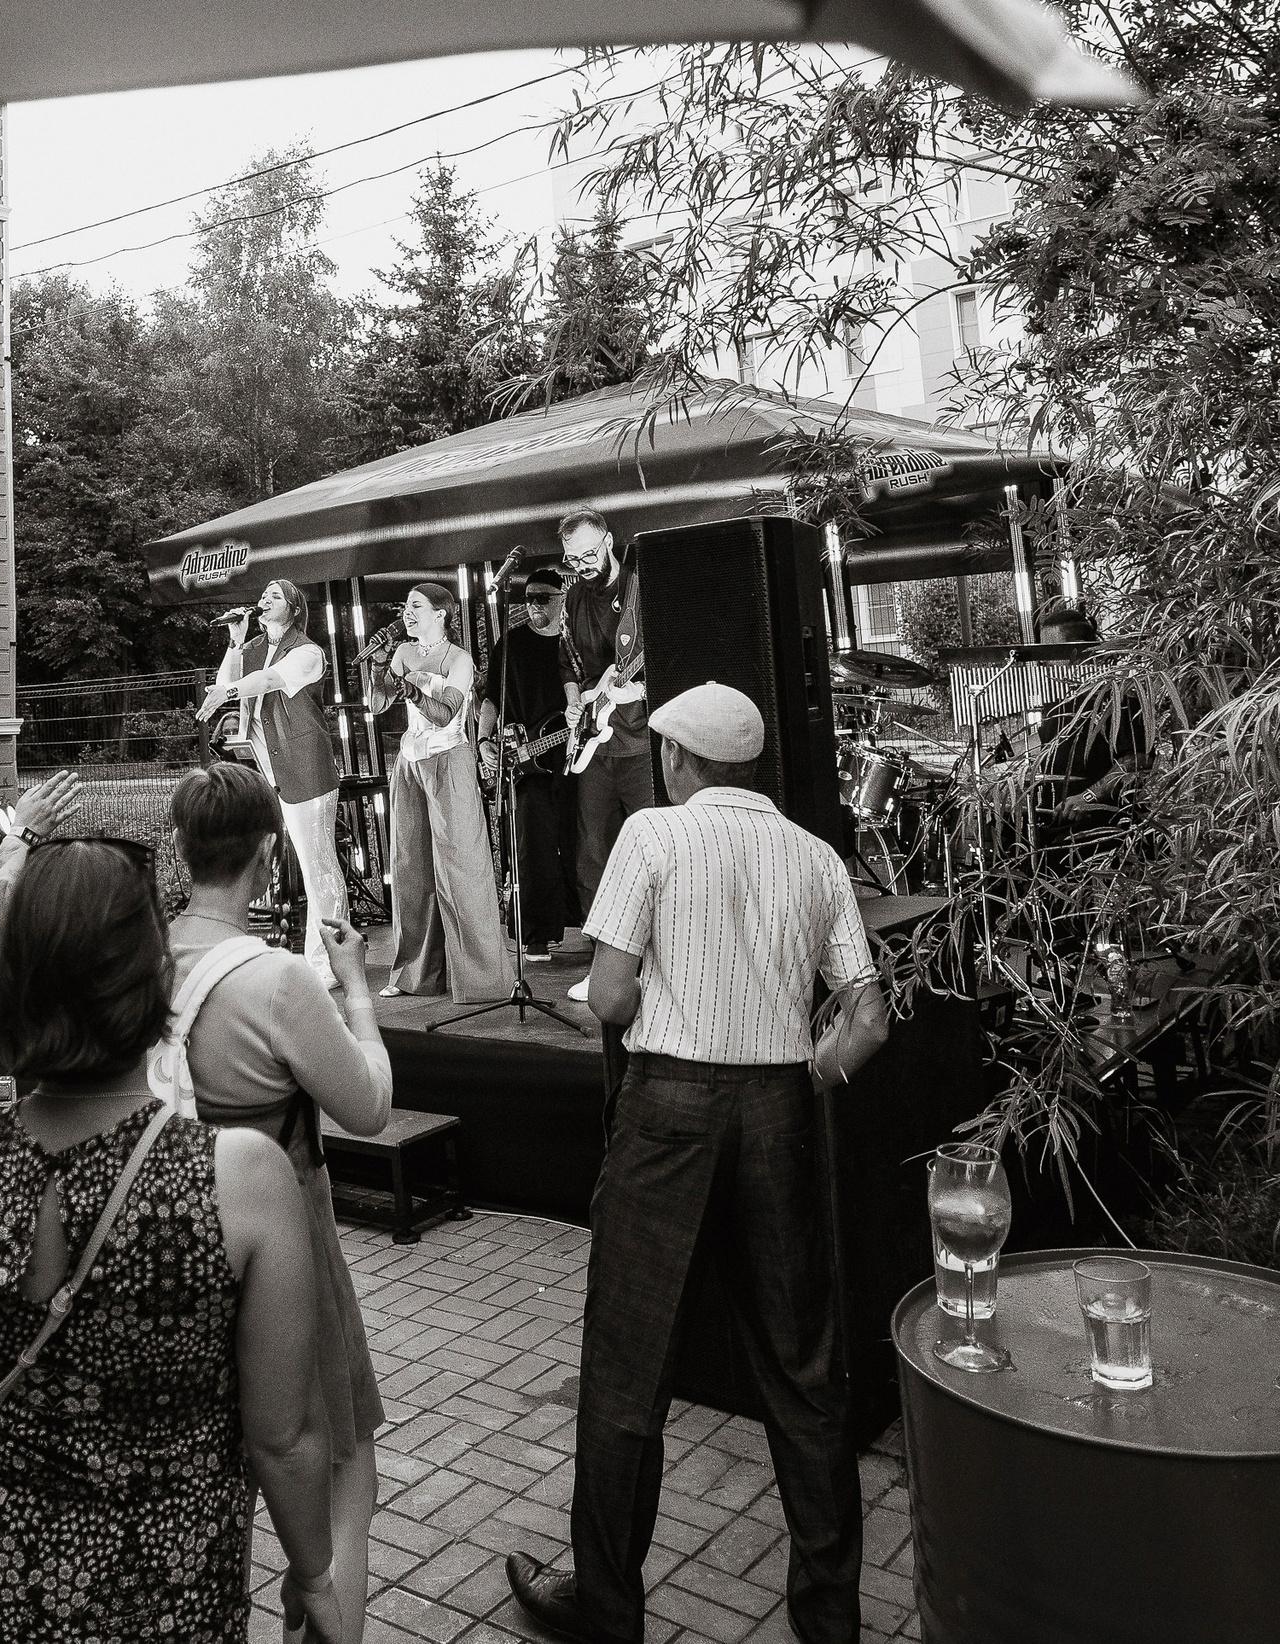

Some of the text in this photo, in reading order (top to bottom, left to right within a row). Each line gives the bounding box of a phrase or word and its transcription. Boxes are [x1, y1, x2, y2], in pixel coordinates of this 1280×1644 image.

[889, 473, 928, 490] RUSH
[181, 545, 248, 582] Adrenaline
[198, 570, 228, 582] RUSH
